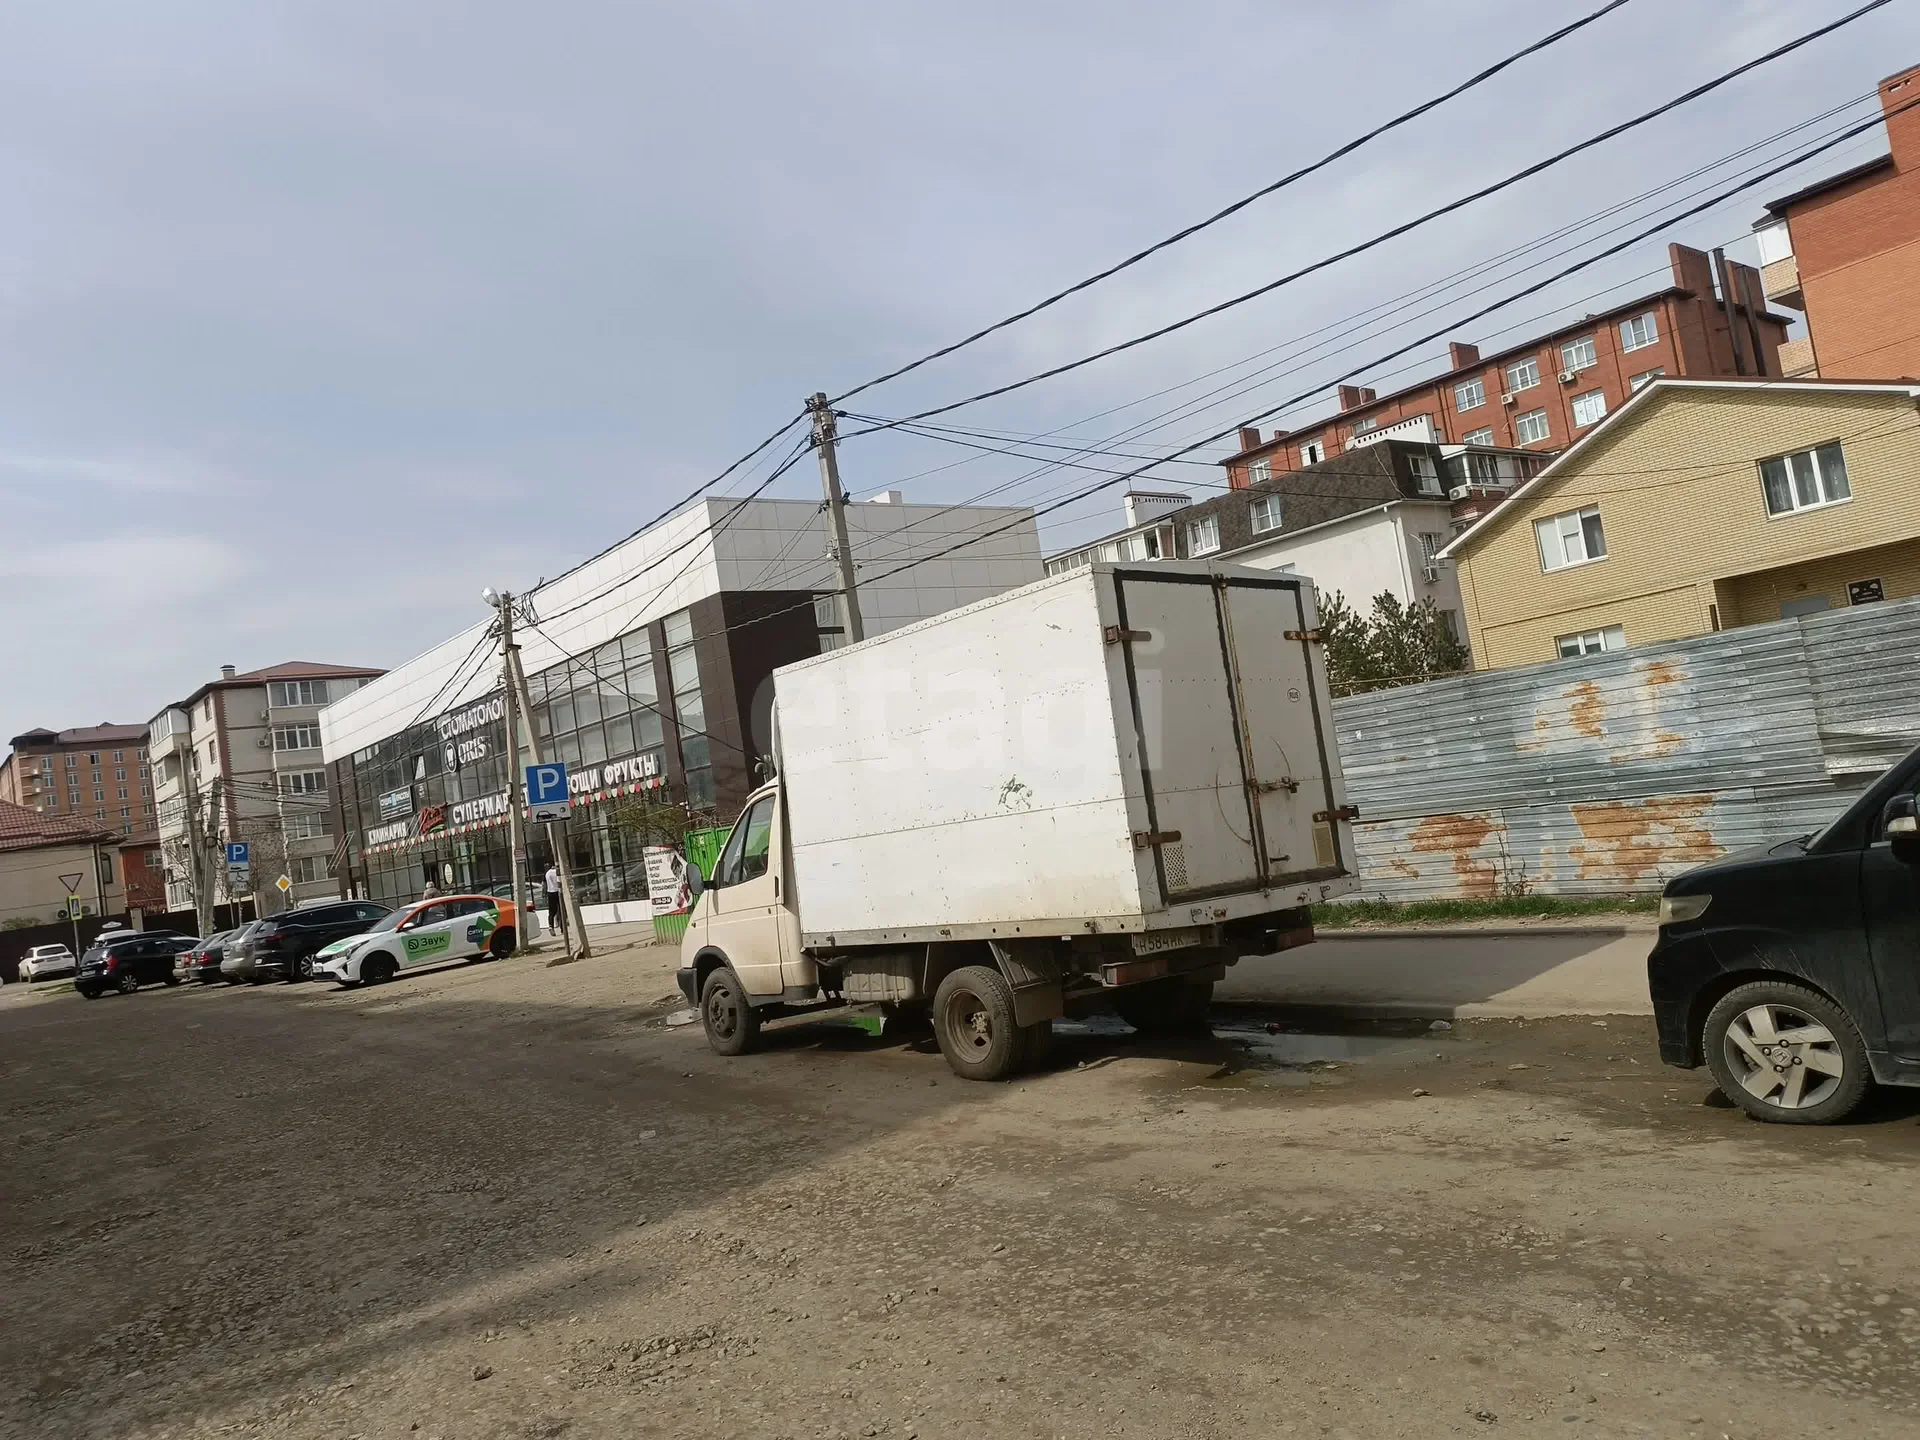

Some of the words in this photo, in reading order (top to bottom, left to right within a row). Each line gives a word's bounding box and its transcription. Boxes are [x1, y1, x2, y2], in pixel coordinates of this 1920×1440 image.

[441, 697, 507, 740] СТОМАТОЛОГ
[457, 736, 487, 764] ORIS
[603, 753, 656, 786] ФРУКТЫ
[368, 822, 407, 846] КУЛИНАРИЯ
[420, 936, 446, 947] Звук
